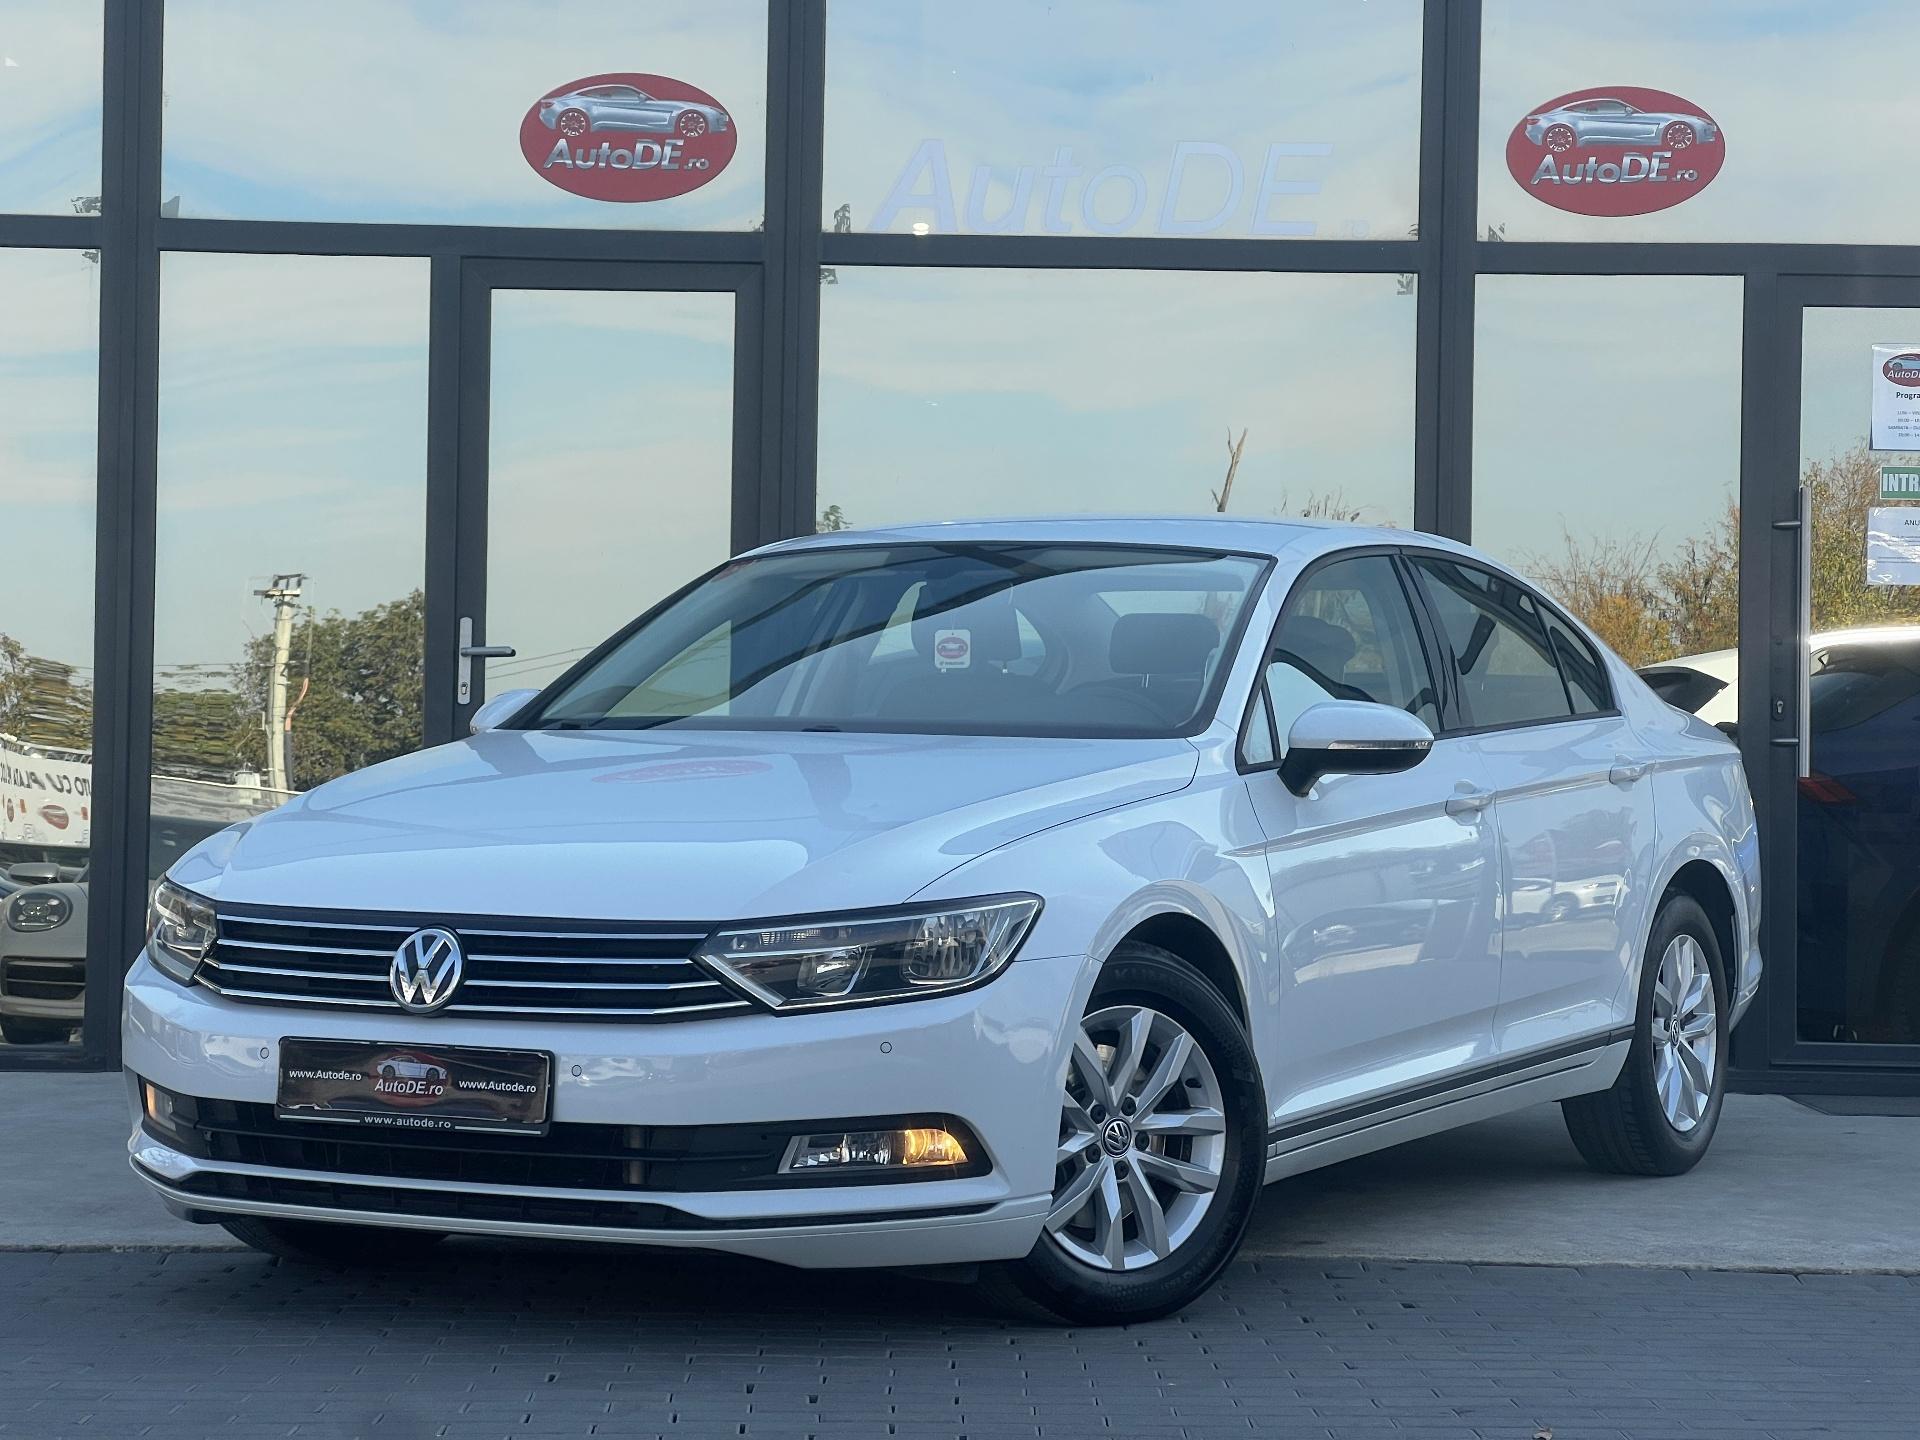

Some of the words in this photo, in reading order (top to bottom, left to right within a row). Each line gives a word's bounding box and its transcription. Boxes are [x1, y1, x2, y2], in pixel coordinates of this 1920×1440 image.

[1887, 370, 1920, 379] AutoD
[289, 1069, 362, 1081] www.Autode.ro
[374, 1078, 444, 1096] AutoDE.ro
[458, 1080, 537, 1093] www.Autode.ro
[364, 1115, 451, 1129] www.autode.ro
